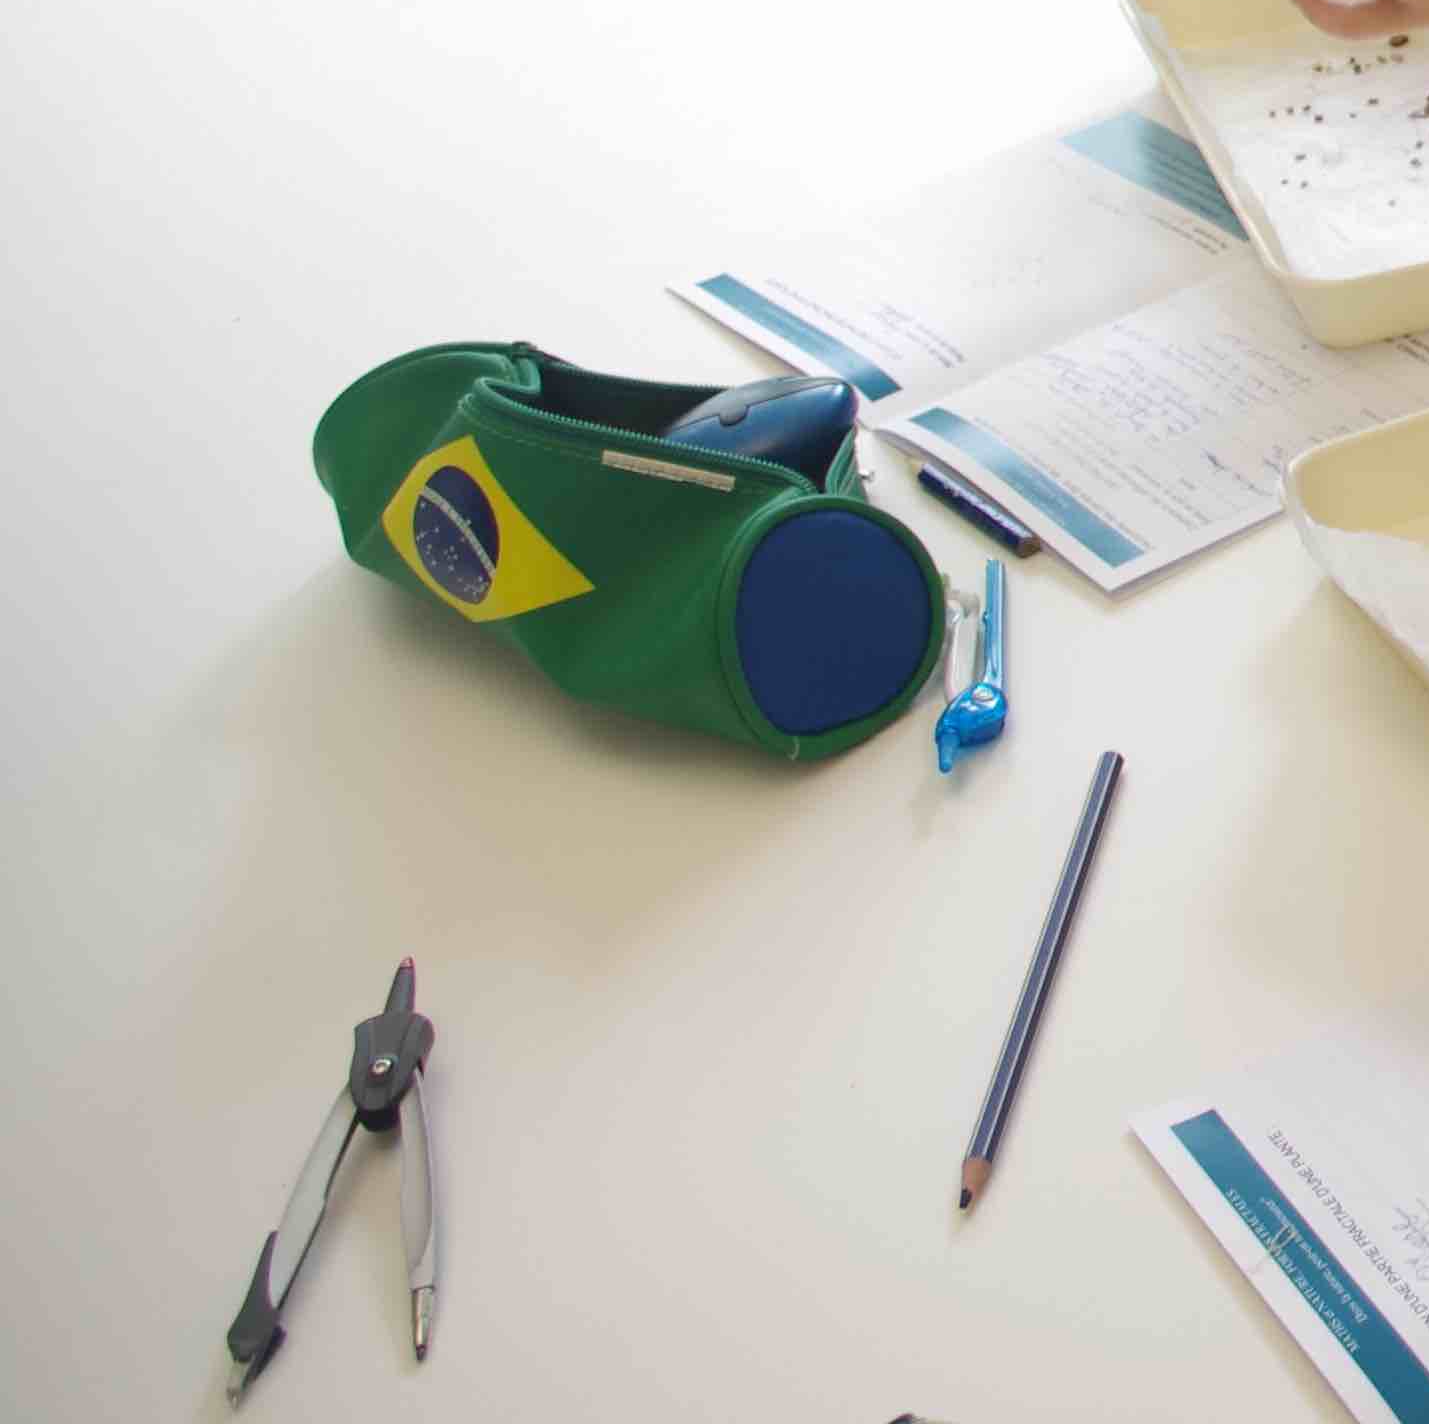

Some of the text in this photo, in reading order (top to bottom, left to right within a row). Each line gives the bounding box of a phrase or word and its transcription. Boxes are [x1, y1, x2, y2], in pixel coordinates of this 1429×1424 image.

[1266, 1129, 1307, 1167] PLANTE
[1321, 1195, 1373, 1246] FRACTALE
[1363, 1246, 1403, 1283] PARTIE
